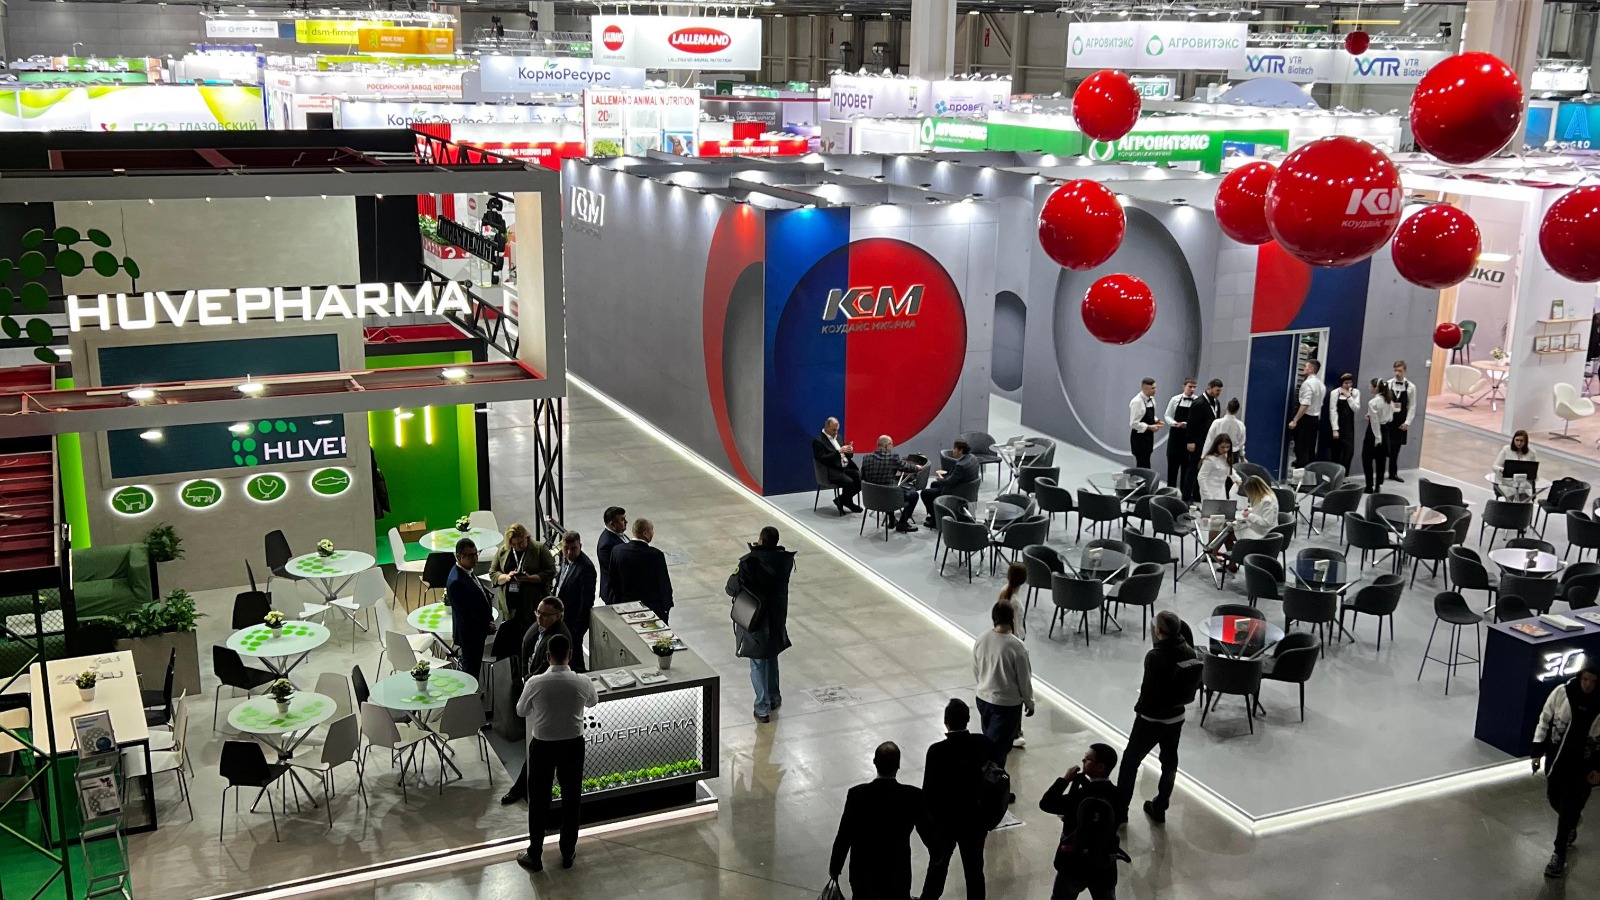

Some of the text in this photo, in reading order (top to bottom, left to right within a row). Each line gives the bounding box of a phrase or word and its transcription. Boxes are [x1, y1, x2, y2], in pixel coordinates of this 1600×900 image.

[671, 33, 729, 46] LALLEMAND
[1085, 37, 1134, 48] АГРОВИТЭКС
[1168, 37, 1239, 49] АГРОВИТЭКС
[1289, 56, 1302, 65] VTR
[1404, 58, 1420, 67] VTR
[518, 67, 611, 82] КормоРесурс
[1287, 66, 1314, 75] Biotech
[366, 82, 410, 91] РОССИЙСКИЙ
[411, 83, 432, 92] ЗАВОД
[591, 96, 695, 105] LALLEMAND ANIMAL NUTRITION
[833, 91, 874, 112] провет
[1117, 134, 1210, 151] АГРОВИТЭКС
[66, 280, 472, 332] HUVEPHARMA
